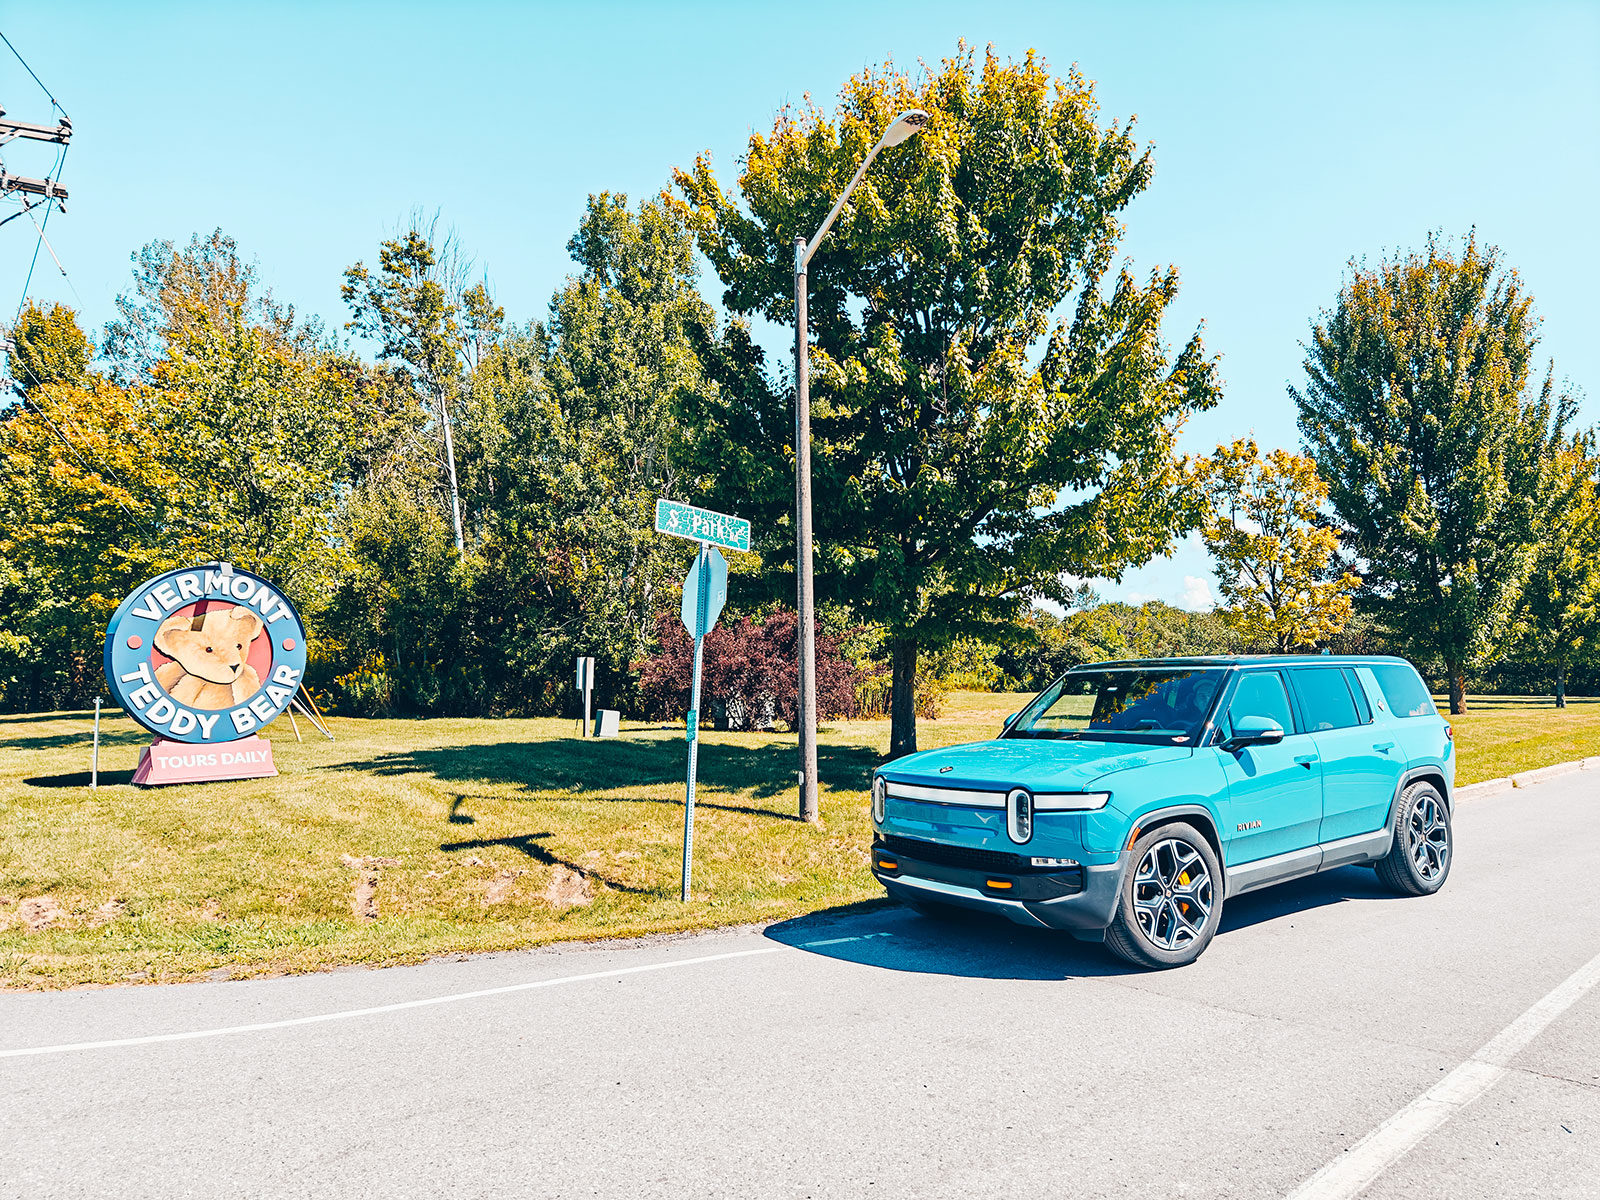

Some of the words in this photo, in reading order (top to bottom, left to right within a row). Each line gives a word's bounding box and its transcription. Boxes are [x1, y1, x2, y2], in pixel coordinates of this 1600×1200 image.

[692, 513, 725, 539] Park
[132, 571, 293, 624] VERMONT
[121, 662, 220, 739] TEDDY
[230, 664, 300, 735] BEAR
[157, 753, 217, 769] TOURS
[221, 750, 268, 766] DAILY
[1236, 820, 1262, 832] RIVIAN
